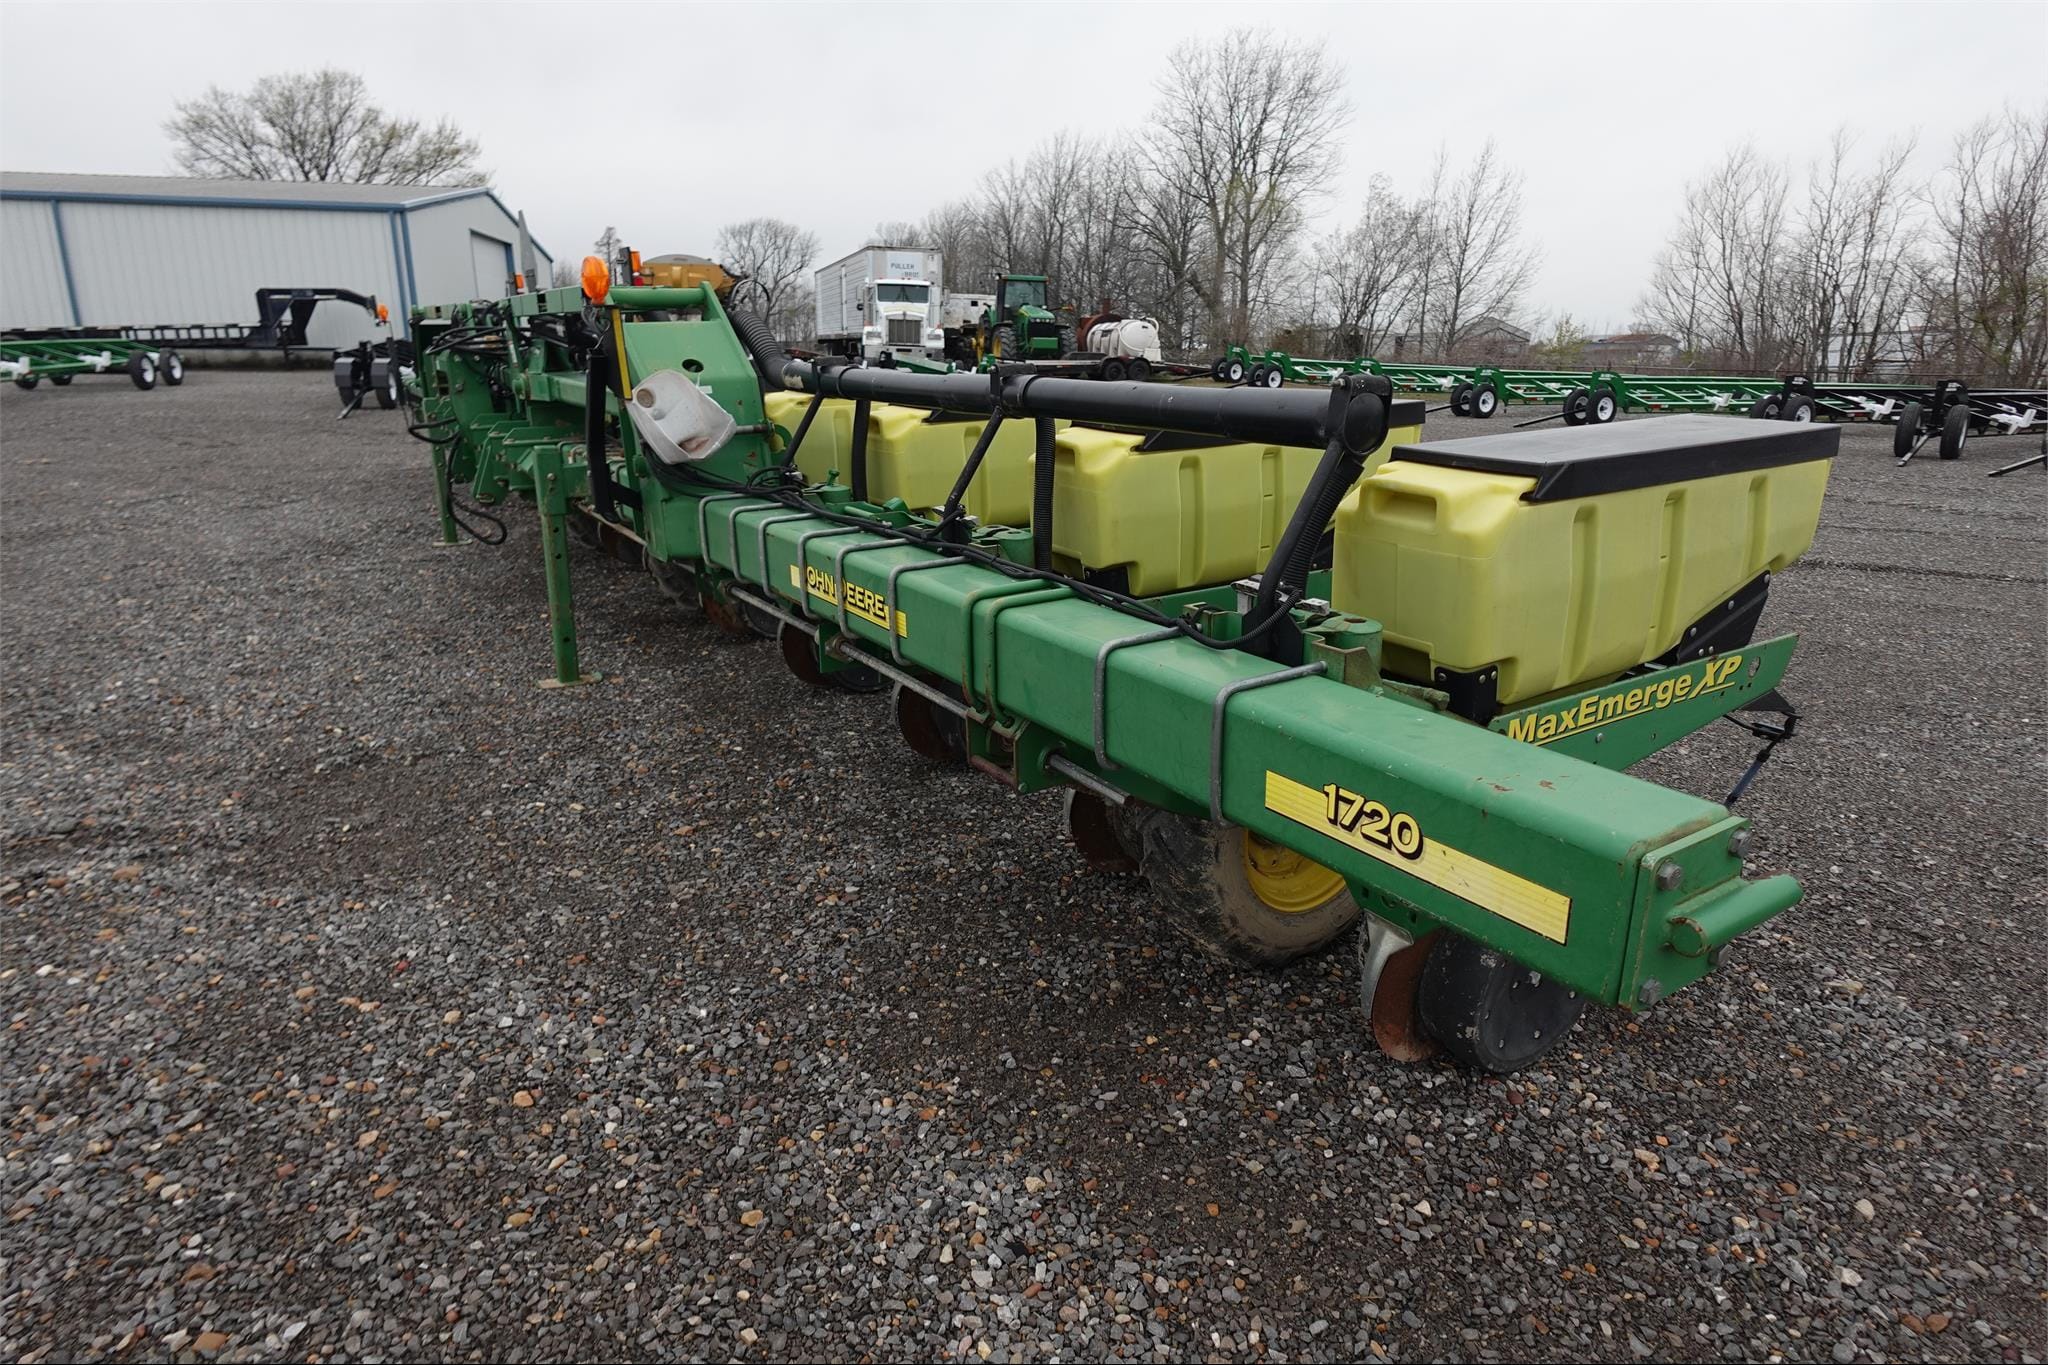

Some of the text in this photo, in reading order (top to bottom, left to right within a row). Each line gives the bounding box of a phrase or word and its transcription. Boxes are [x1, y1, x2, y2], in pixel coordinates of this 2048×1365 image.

[806, 565, 835, 598] OHN
[1507, 654, 1743, 744] MaxEmerge XP
[1322, 782, 1424, 860] 1720
